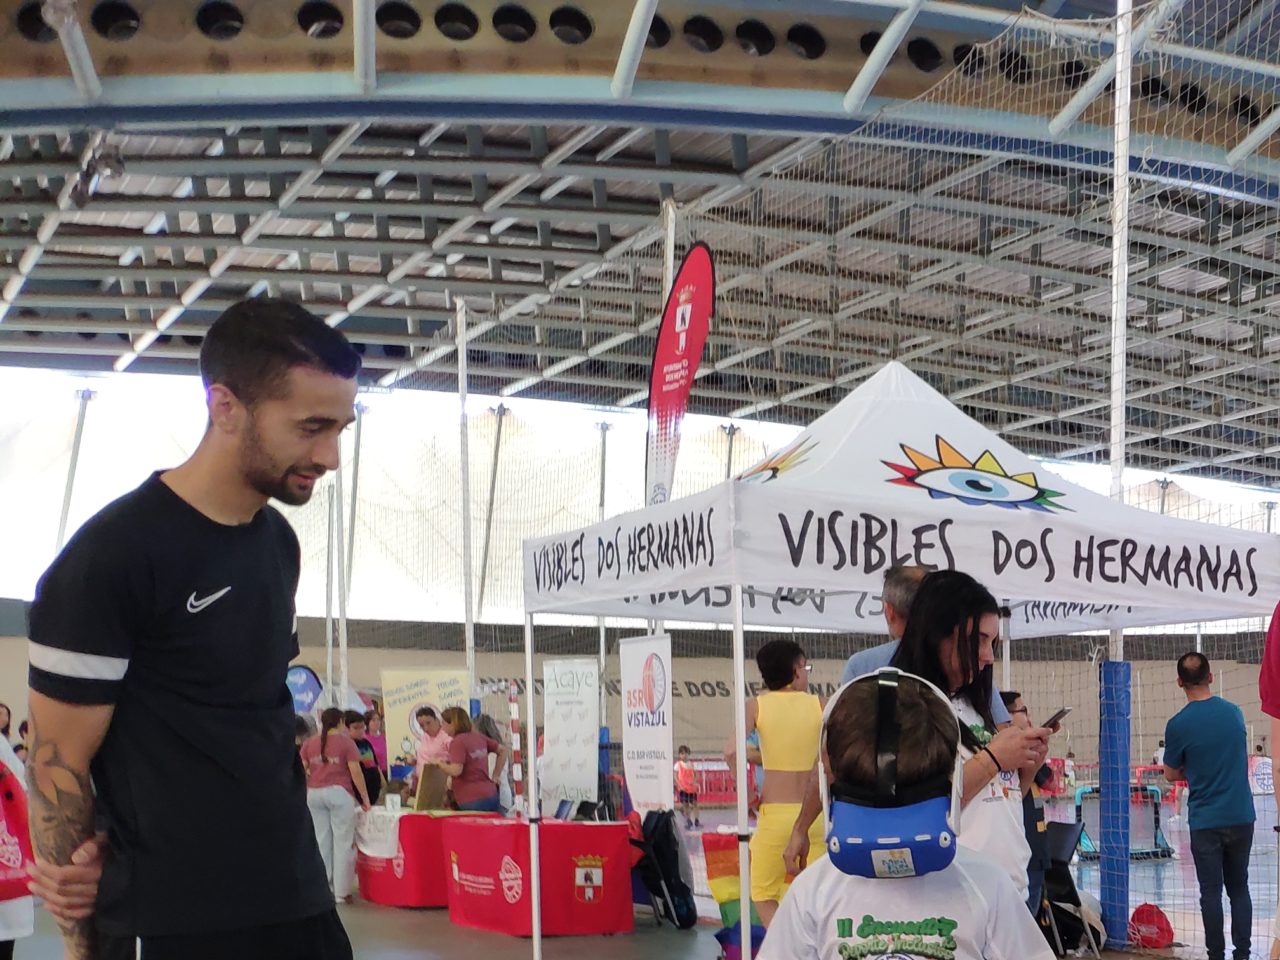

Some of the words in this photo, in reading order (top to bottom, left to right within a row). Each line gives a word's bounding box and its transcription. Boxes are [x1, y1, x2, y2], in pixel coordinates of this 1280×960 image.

[534, 532, 585, 593] VISIBLES
[597, 526, 621, 580] DOS
[627, 507, 714, 575] HERMANAS
[778, 509, 955, 574] VISIBLES
[991, 527, 1054, 582] DOS
[1073, 535, 1258, 596] HERMANAS
[546, 665, 594, 696] Acaye
[684, 680, 731, 698] DOS
[627, 688, 644, 708] BSR
[627, 711, 667, 728] VISTAZUL
